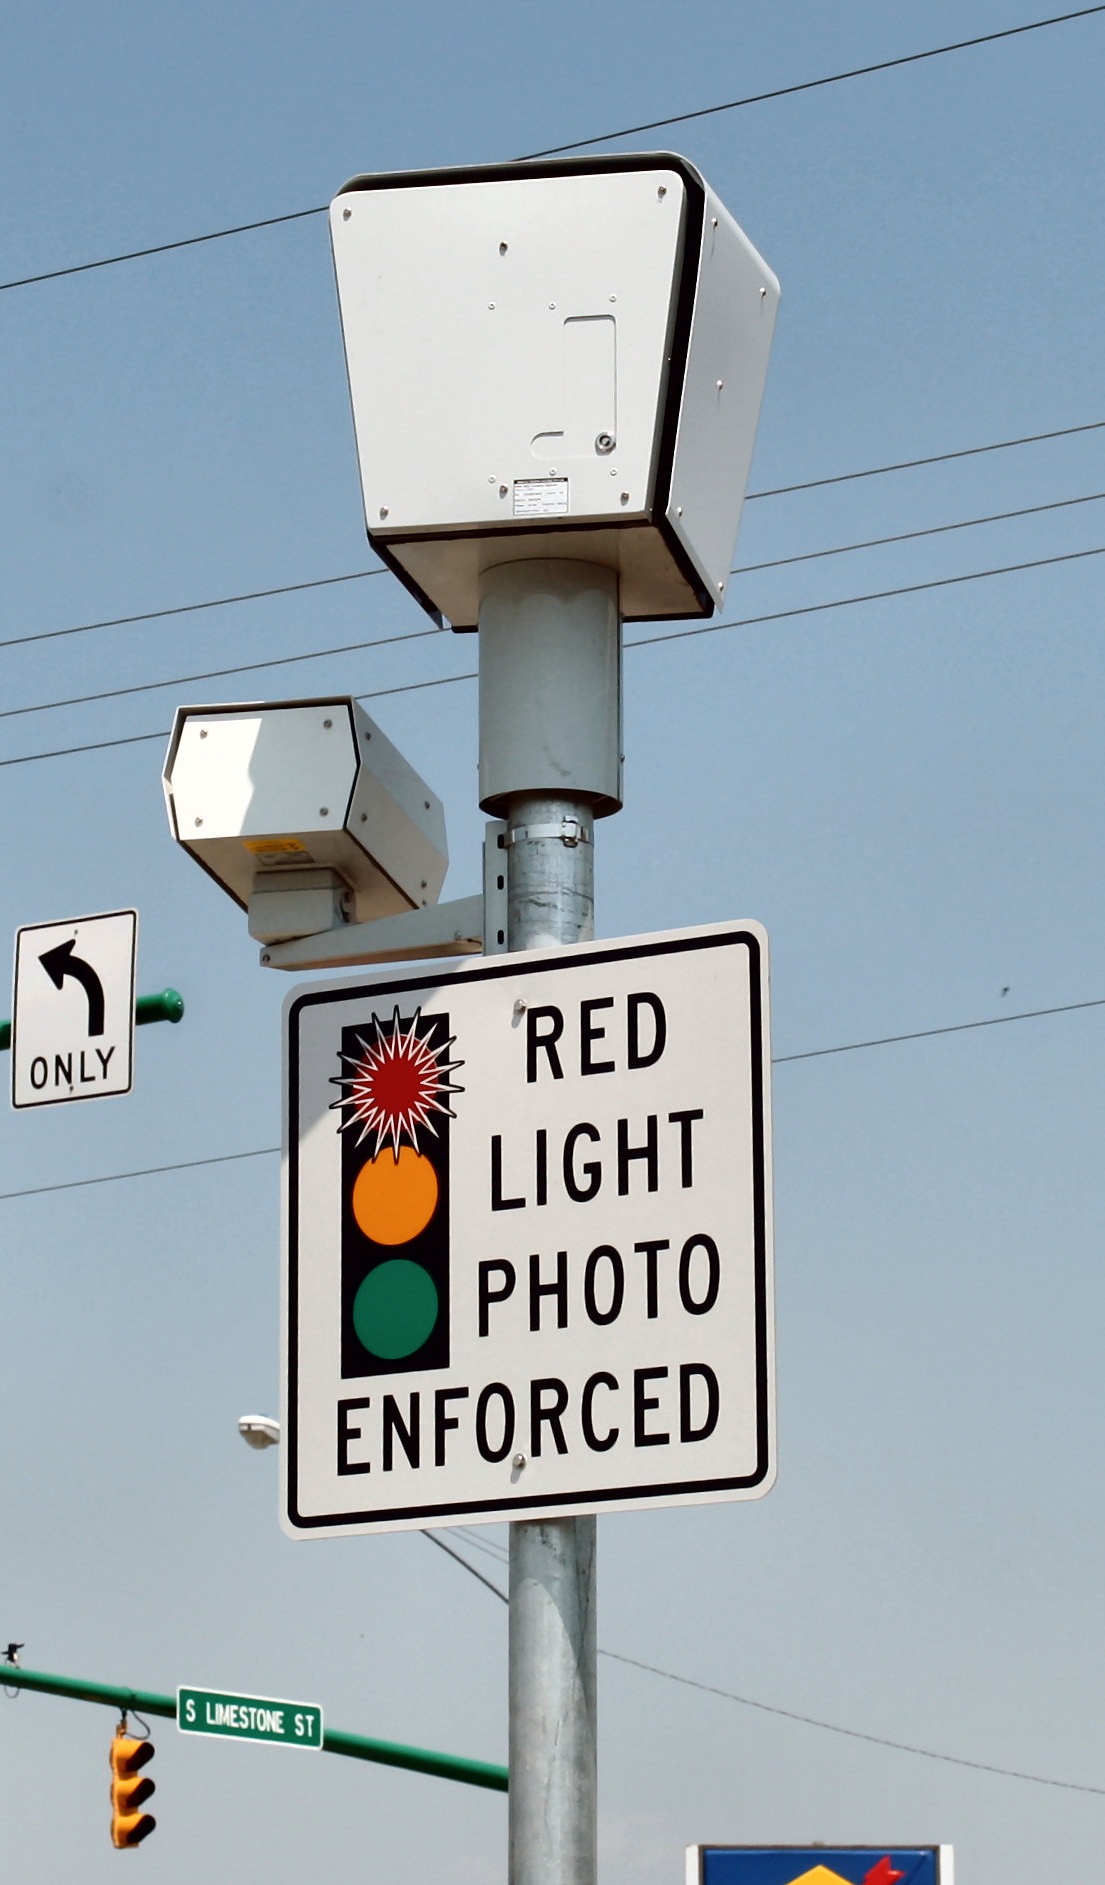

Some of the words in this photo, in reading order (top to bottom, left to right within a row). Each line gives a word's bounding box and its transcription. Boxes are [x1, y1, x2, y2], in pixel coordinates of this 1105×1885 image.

[30, 1046, 115, 1089] ONLY
[526, 991, 667, 1083] RED
[490, 1108, 705, 1212] LIGHT
[478, 1233, 721, 1338] PHOTO
[336, 1362, 721, 1477] ENFORCED
[185, 1699, 196, 1722] S
[206, 1702, 285, 1734] LIMESTONE
[294, 1713, 315, 1737] ST
